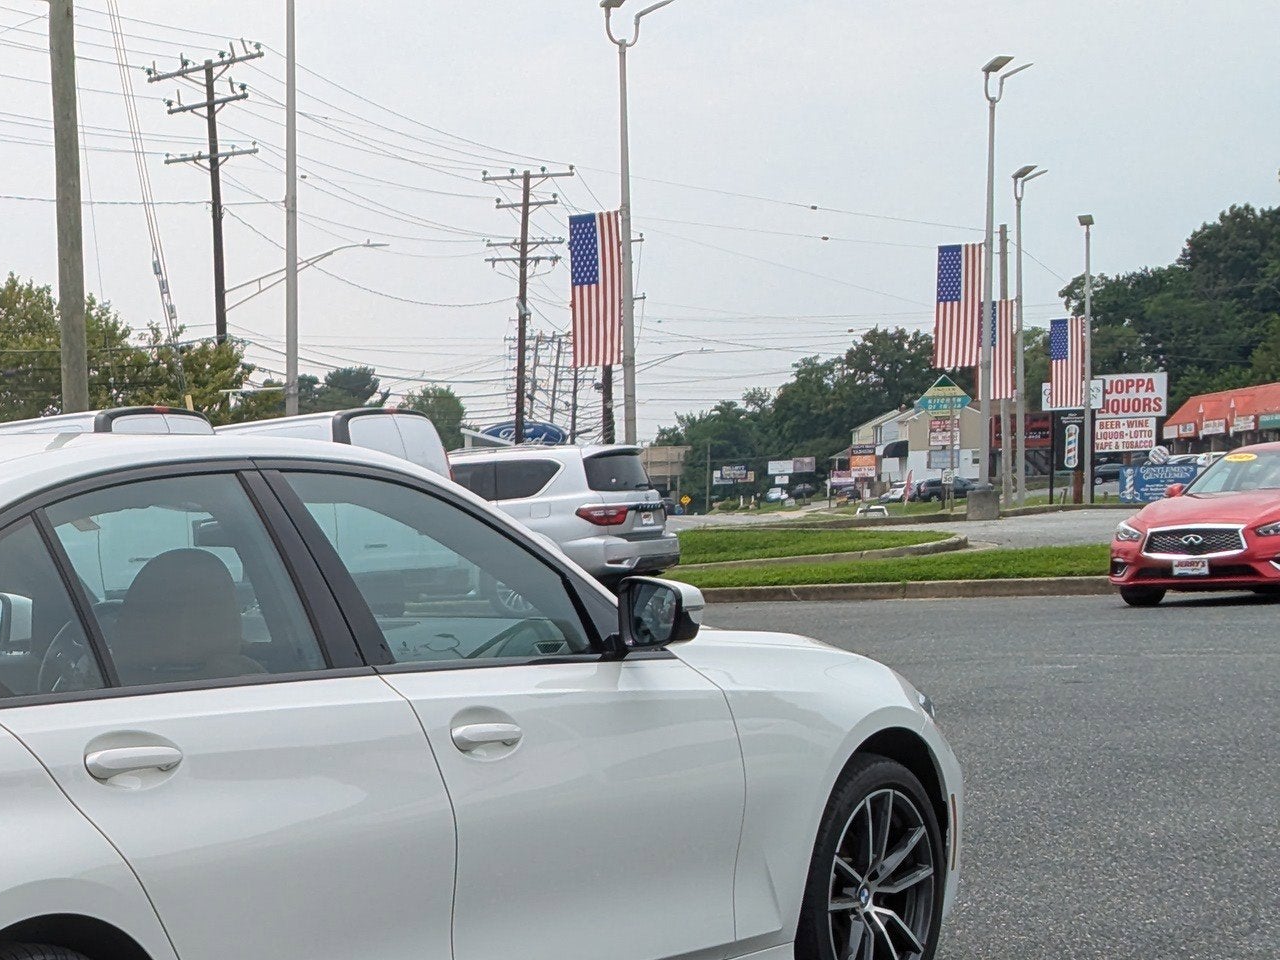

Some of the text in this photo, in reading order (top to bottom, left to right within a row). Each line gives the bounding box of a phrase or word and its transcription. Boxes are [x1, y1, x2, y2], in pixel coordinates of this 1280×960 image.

[1105, 377, 1155, 395] JOPPA
[1099, 419, 1149, 430] BEER WINE
[1096, 429, 1153, 440] LIQUOR LOTTO
[1095, 441, 1112, 450] VAPE
[1121, 439, 1153, 449] TOBACCO
